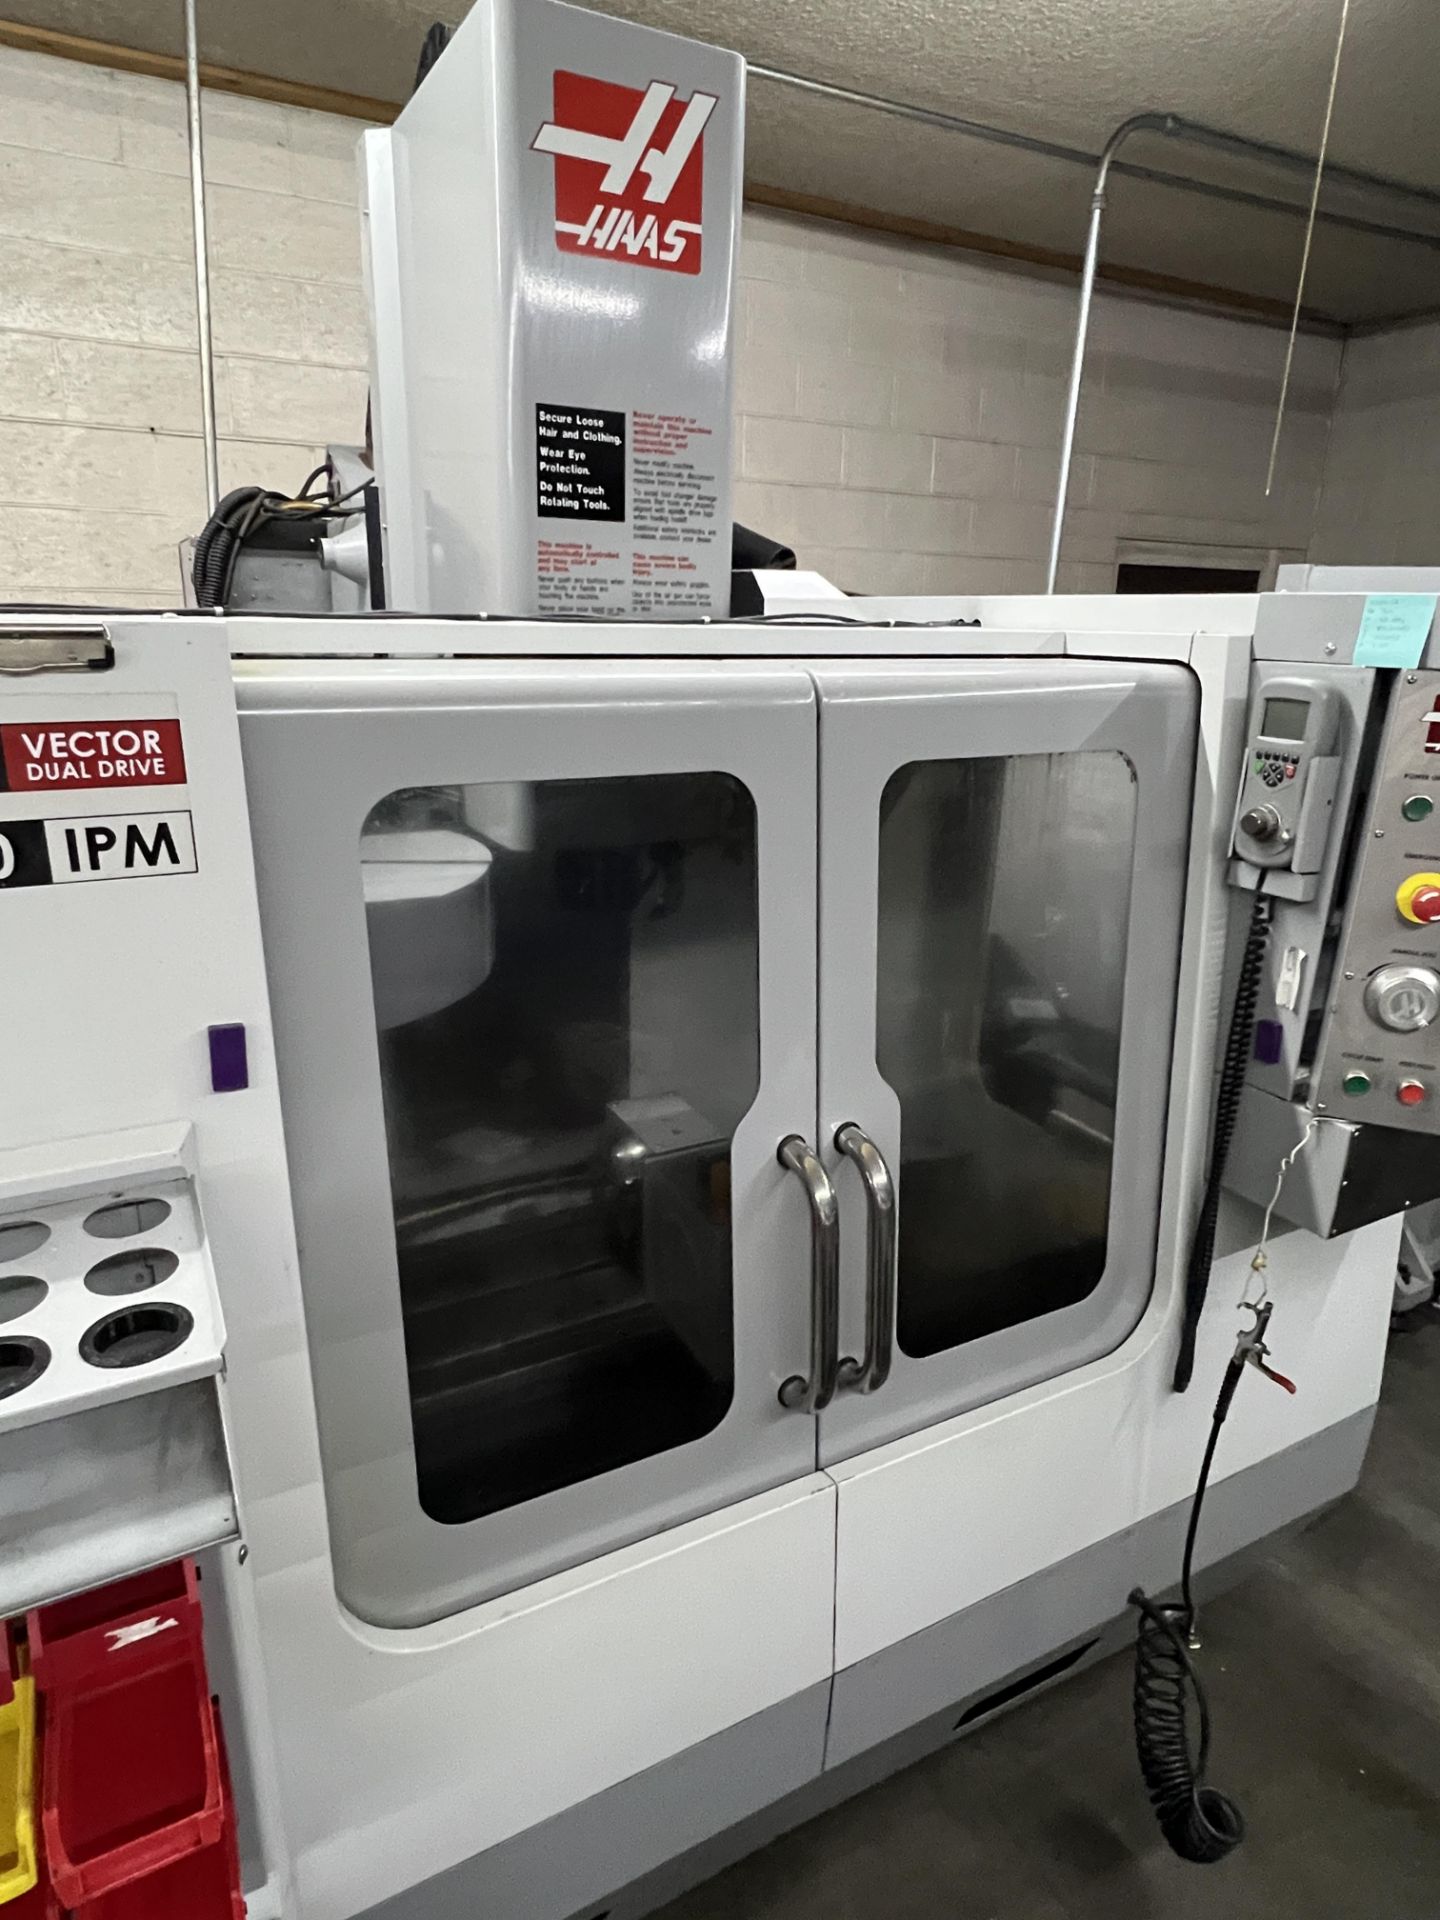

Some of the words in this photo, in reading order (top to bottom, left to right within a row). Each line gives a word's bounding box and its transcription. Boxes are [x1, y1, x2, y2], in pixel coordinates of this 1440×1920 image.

[555, 204, 702, 262] HAAS
[539, 411, 572, 424] Secure
[576, 414, 604, 428] Loose
[539, 426, 558, 437] Hair
[562, 430, 579, 439] and
[583, 430, 622, 445] Clothing.
[540, 446, 564, 458] Wear
[568, 449, 586, 461] Eye
[540, 461, 590, 475] Protection.
[540, 480, 553, 491] Do
[557, 482, 572, 493] Not
[577, 484, 604, 495] Touch
[540, 495, 579, 510] Rotating
[583, 499, 610, 510] Tools.
[21, 729, 163, 759] VECTOR
[26, 761, 92, 781] DUAL
[98, 757, 166, 778] DRIVE
[64, 821, 181, 873] IPM
